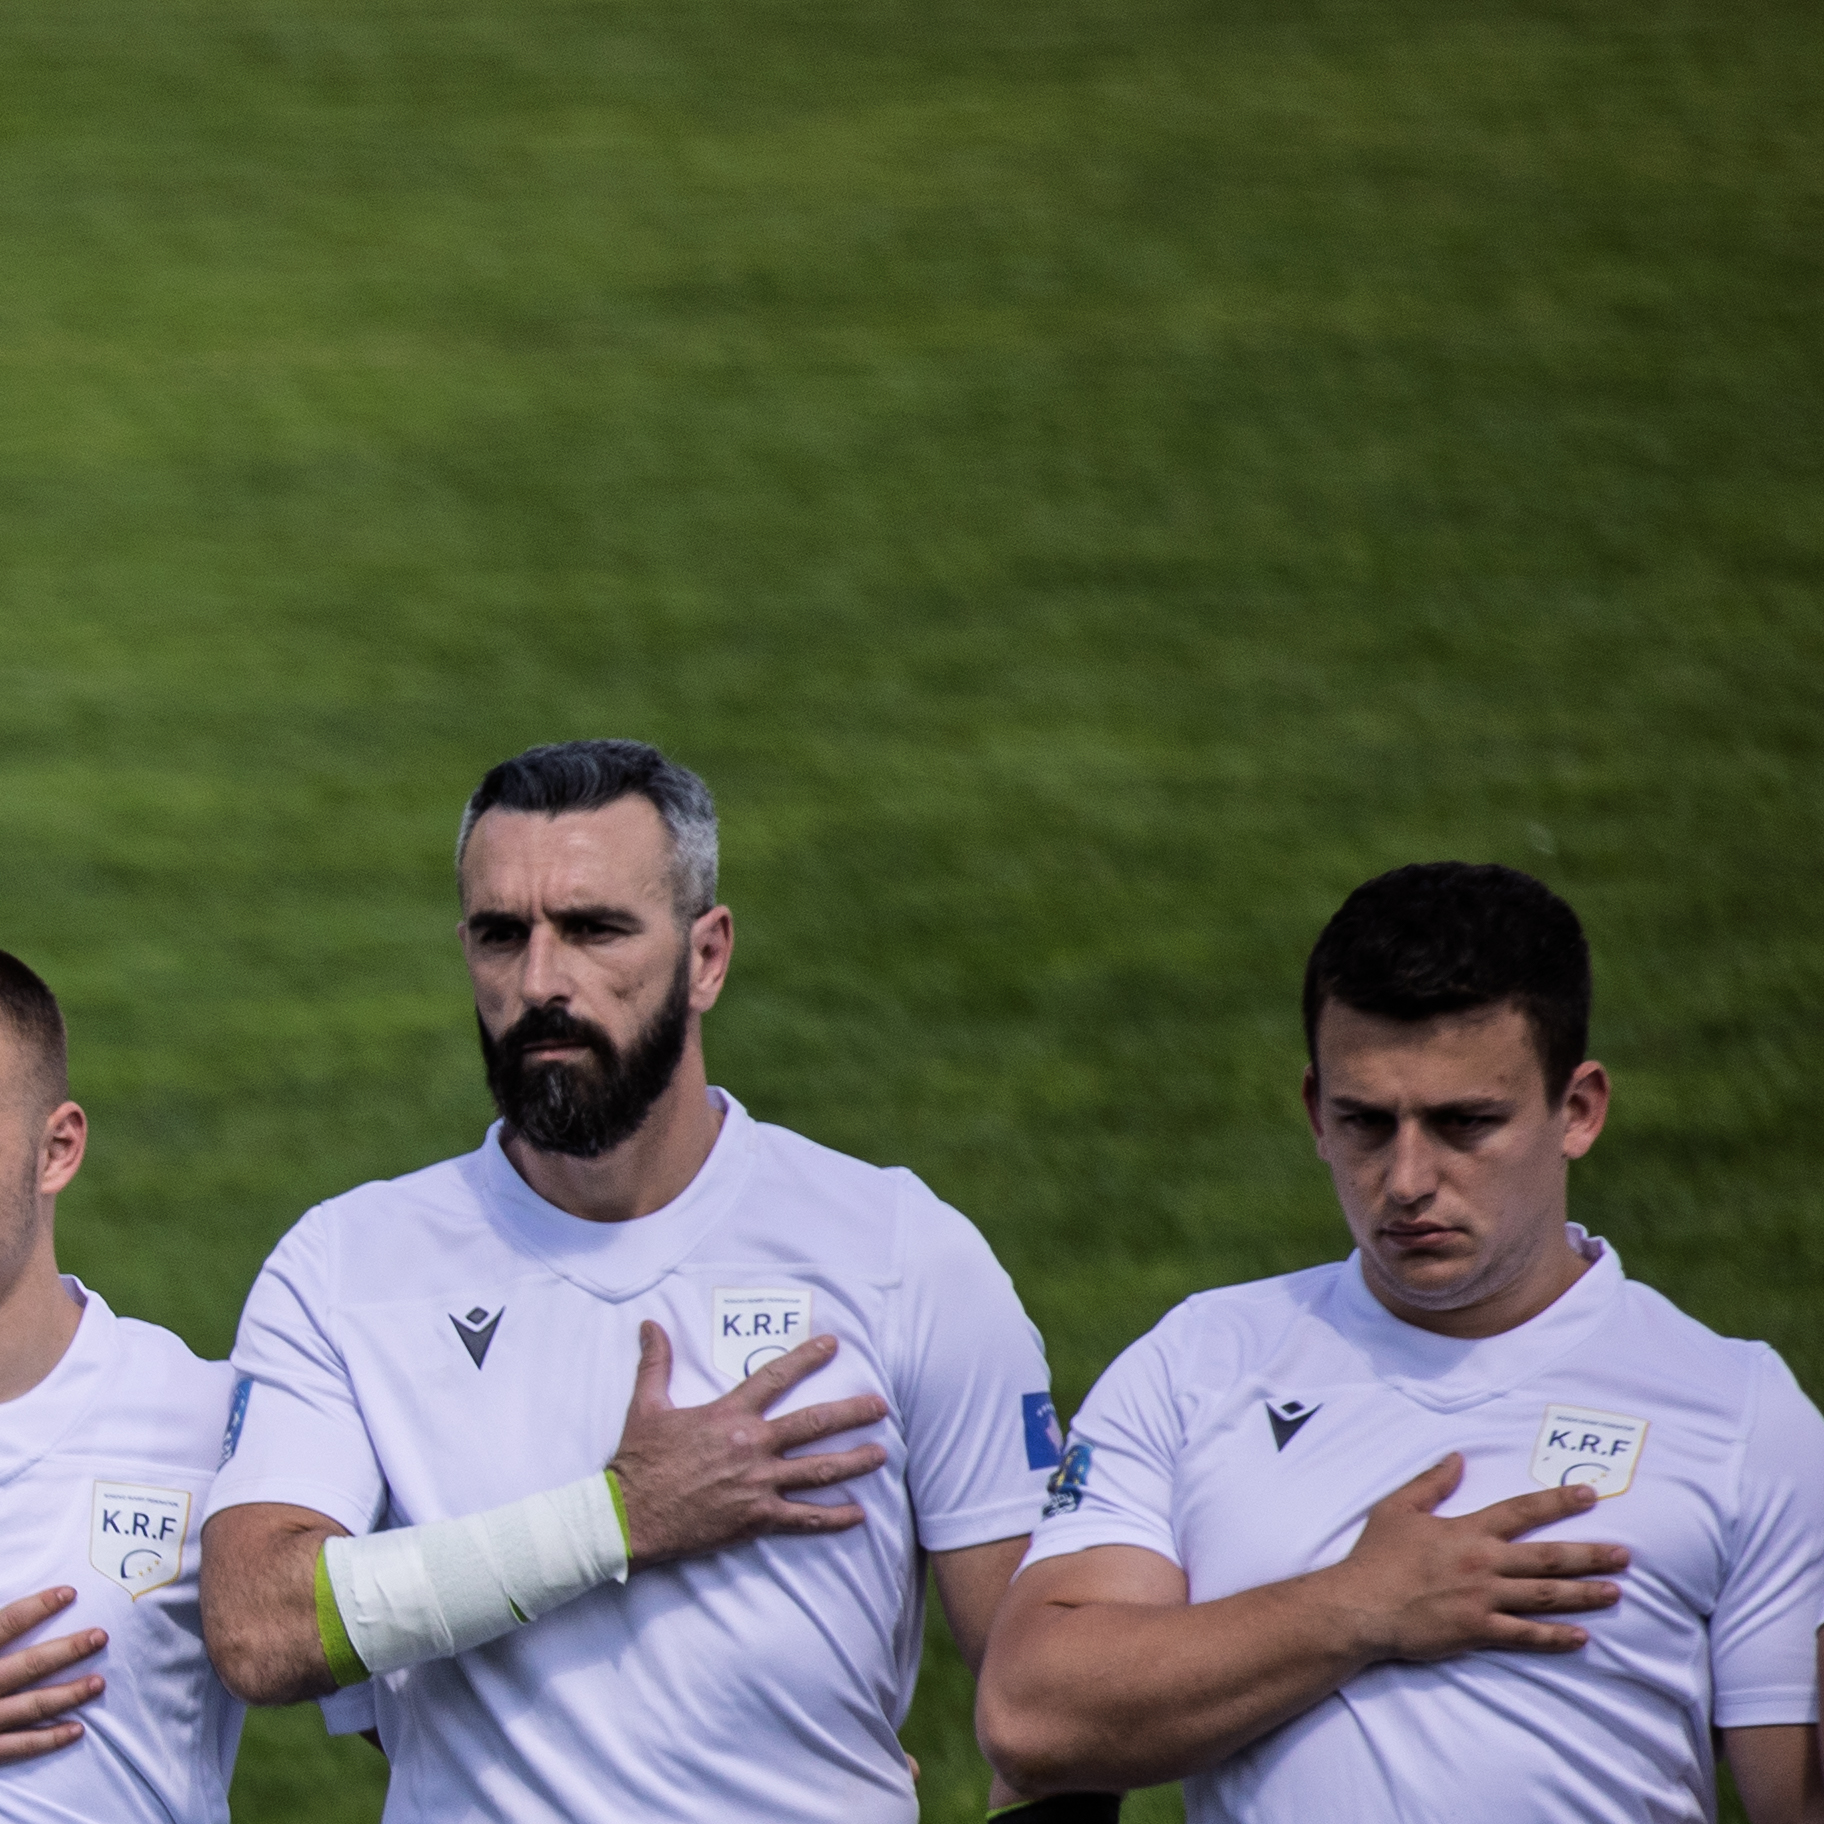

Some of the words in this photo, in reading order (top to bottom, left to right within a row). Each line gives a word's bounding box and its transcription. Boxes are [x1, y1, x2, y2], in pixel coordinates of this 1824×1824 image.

[723, 1311, 800, 1336] K.R.F
[1547, 1429, 1631, 1456] K.R.F
[102, 1508, 178, 1541] K.R.F
